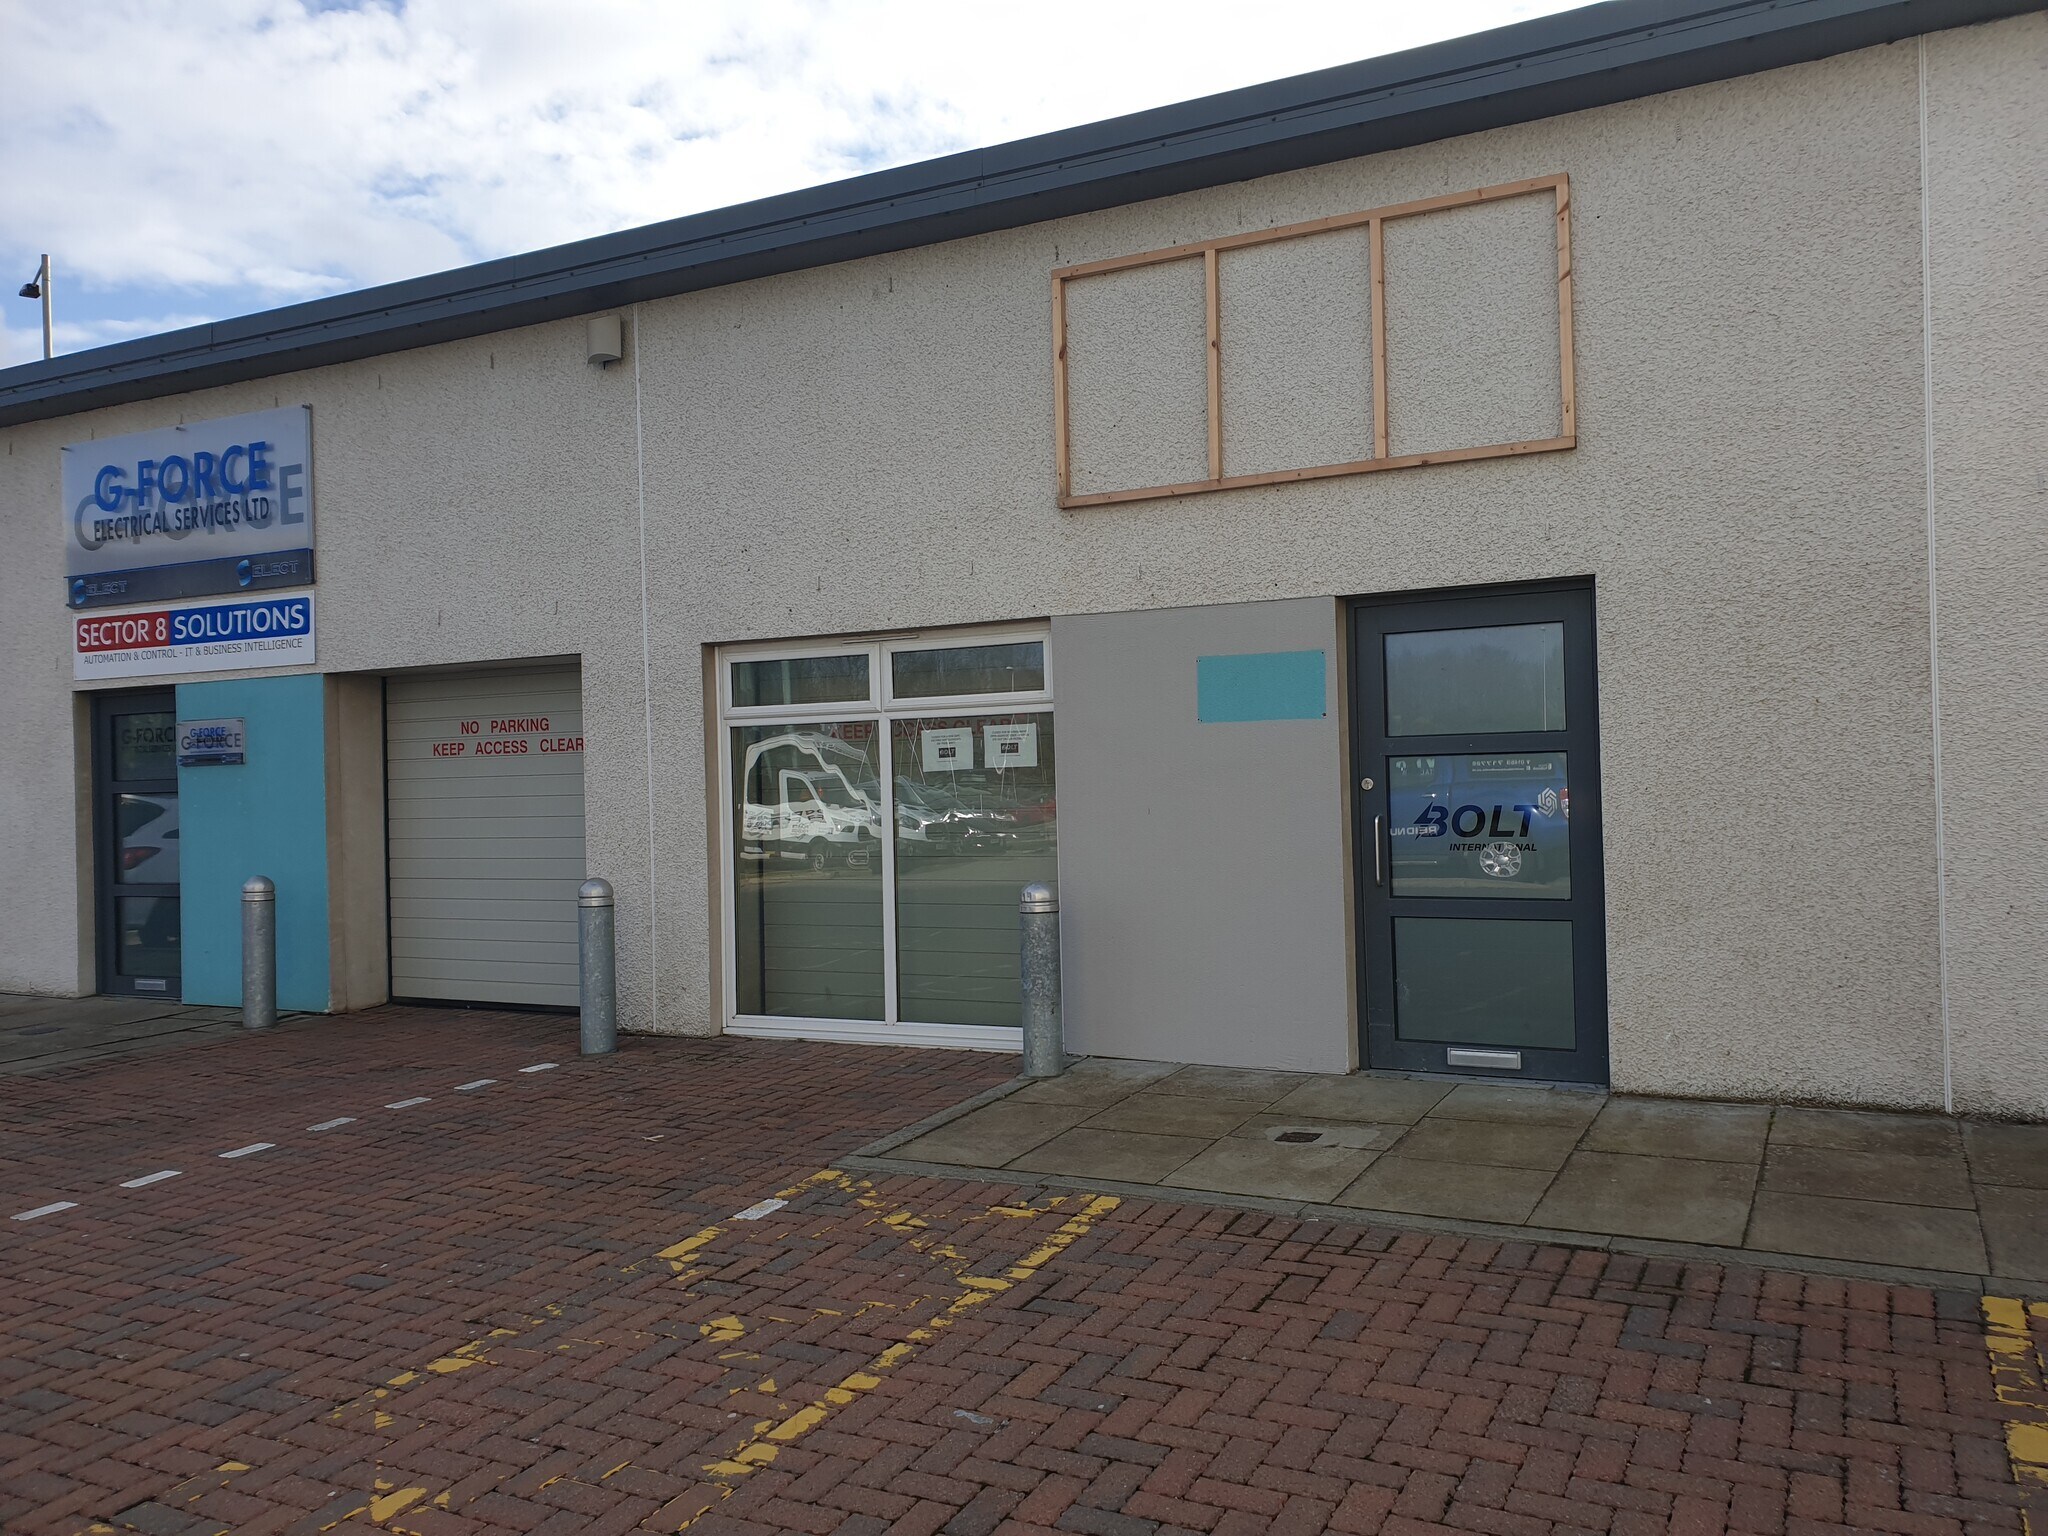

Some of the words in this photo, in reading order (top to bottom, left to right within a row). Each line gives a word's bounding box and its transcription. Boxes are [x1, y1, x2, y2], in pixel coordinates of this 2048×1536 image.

[94, 441, 269, 512] G-FORCE
[94, 511, 169, 542] ELECTRICAL
[175, 501, 240, 531] SERVICES
[245, 497, 270, 521] LTD
[79, 619, 149, 647] SECTOR
[155, 617, 167, 641] 8
[173, 604, 305, 639] SOLUTIONS
[83, 651, 132, 665] AUTOMATION
[133, 652, 140, 661] &
[141, 649, 178, 660] CONTROL
[185, 647, 194, 657] IT
[195, 646, 202, 656] &
[203, 643, 242, 656] BUSINESS
[244, 638, 303, 652] INTELLIGENCE
[461, 721, 480, 735] NO
[490, 717, 550, 734] PARKING
[433, 742, 465, 756] KEEP
[475, 740, 528, 755] ACCESS
[540, 737, 584, 752] CLEAR
[1413, 802, 1541, 841] BOLT
[1449, 843, 1538, 852] INTERNATNAL
